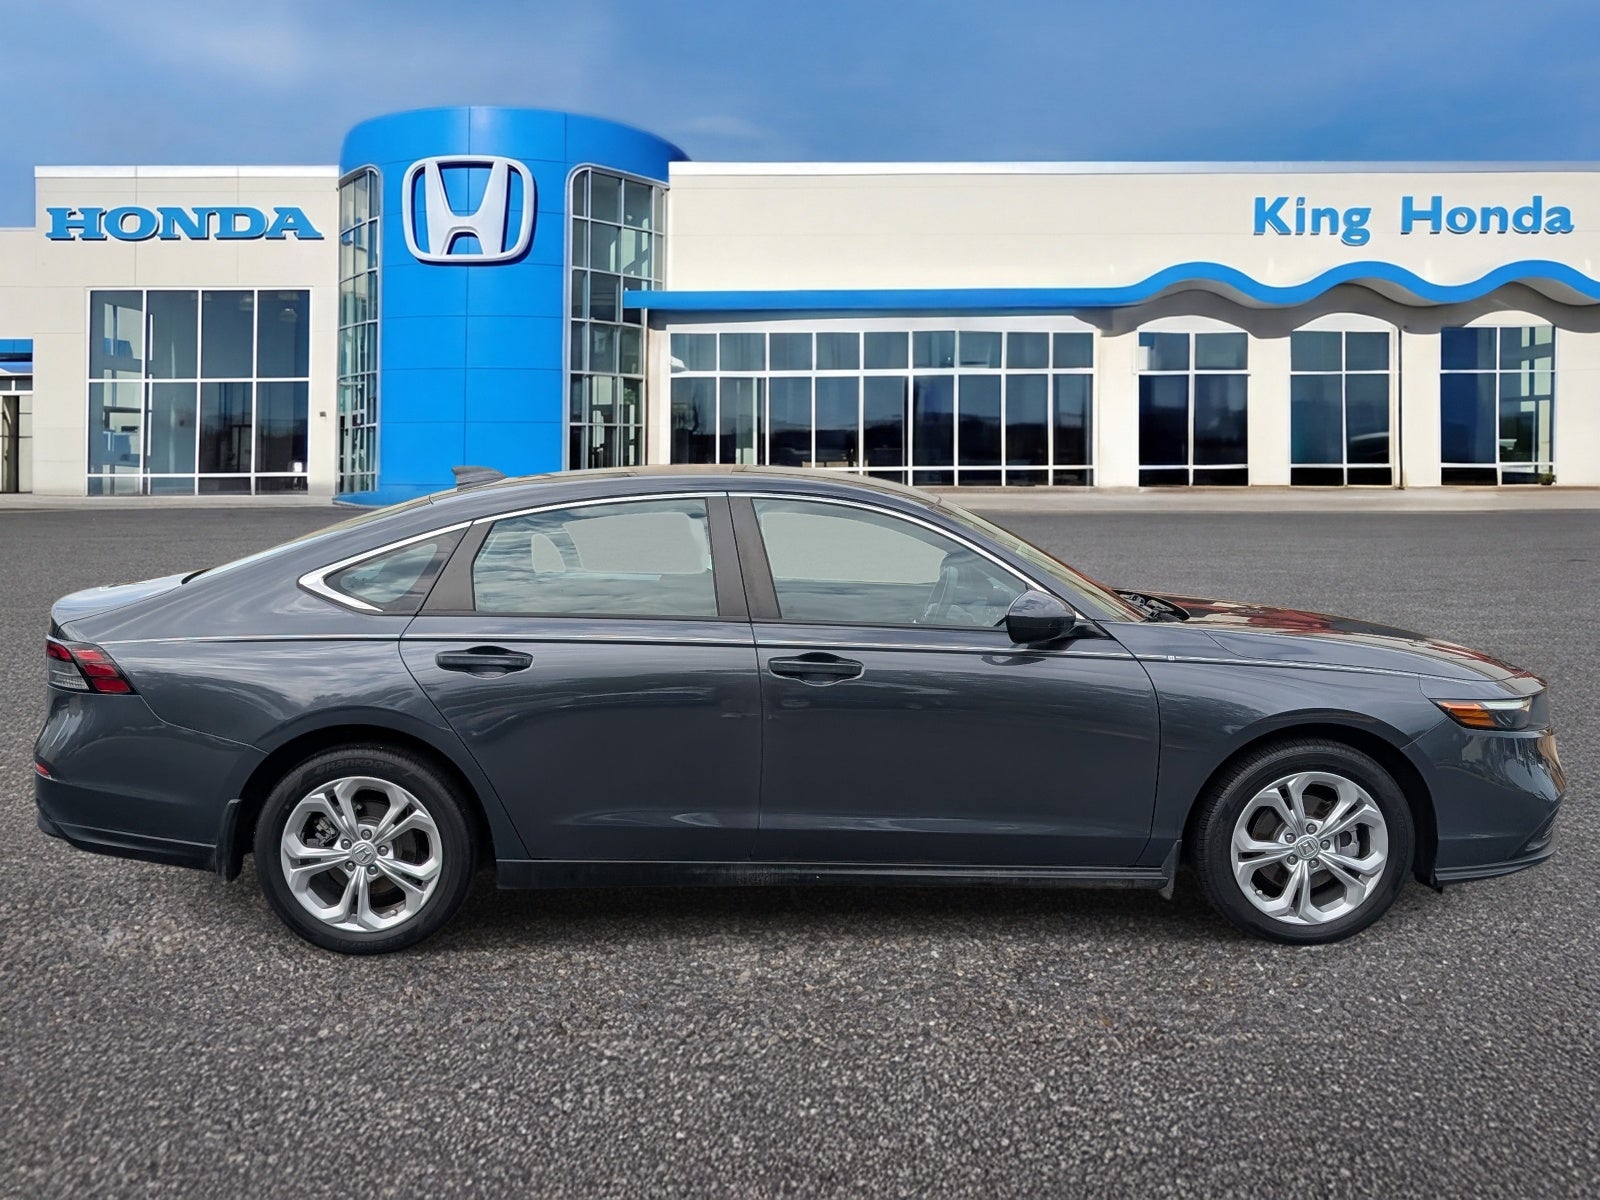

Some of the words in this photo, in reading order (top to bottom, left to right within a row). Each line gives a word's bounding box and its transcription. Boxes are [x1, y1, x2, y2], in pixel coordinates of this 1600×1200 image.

[46, 206, 324, 241] HONDA
[1254, 196, 1371, 246] King
[1401, 195, 1574, 235] Honda
